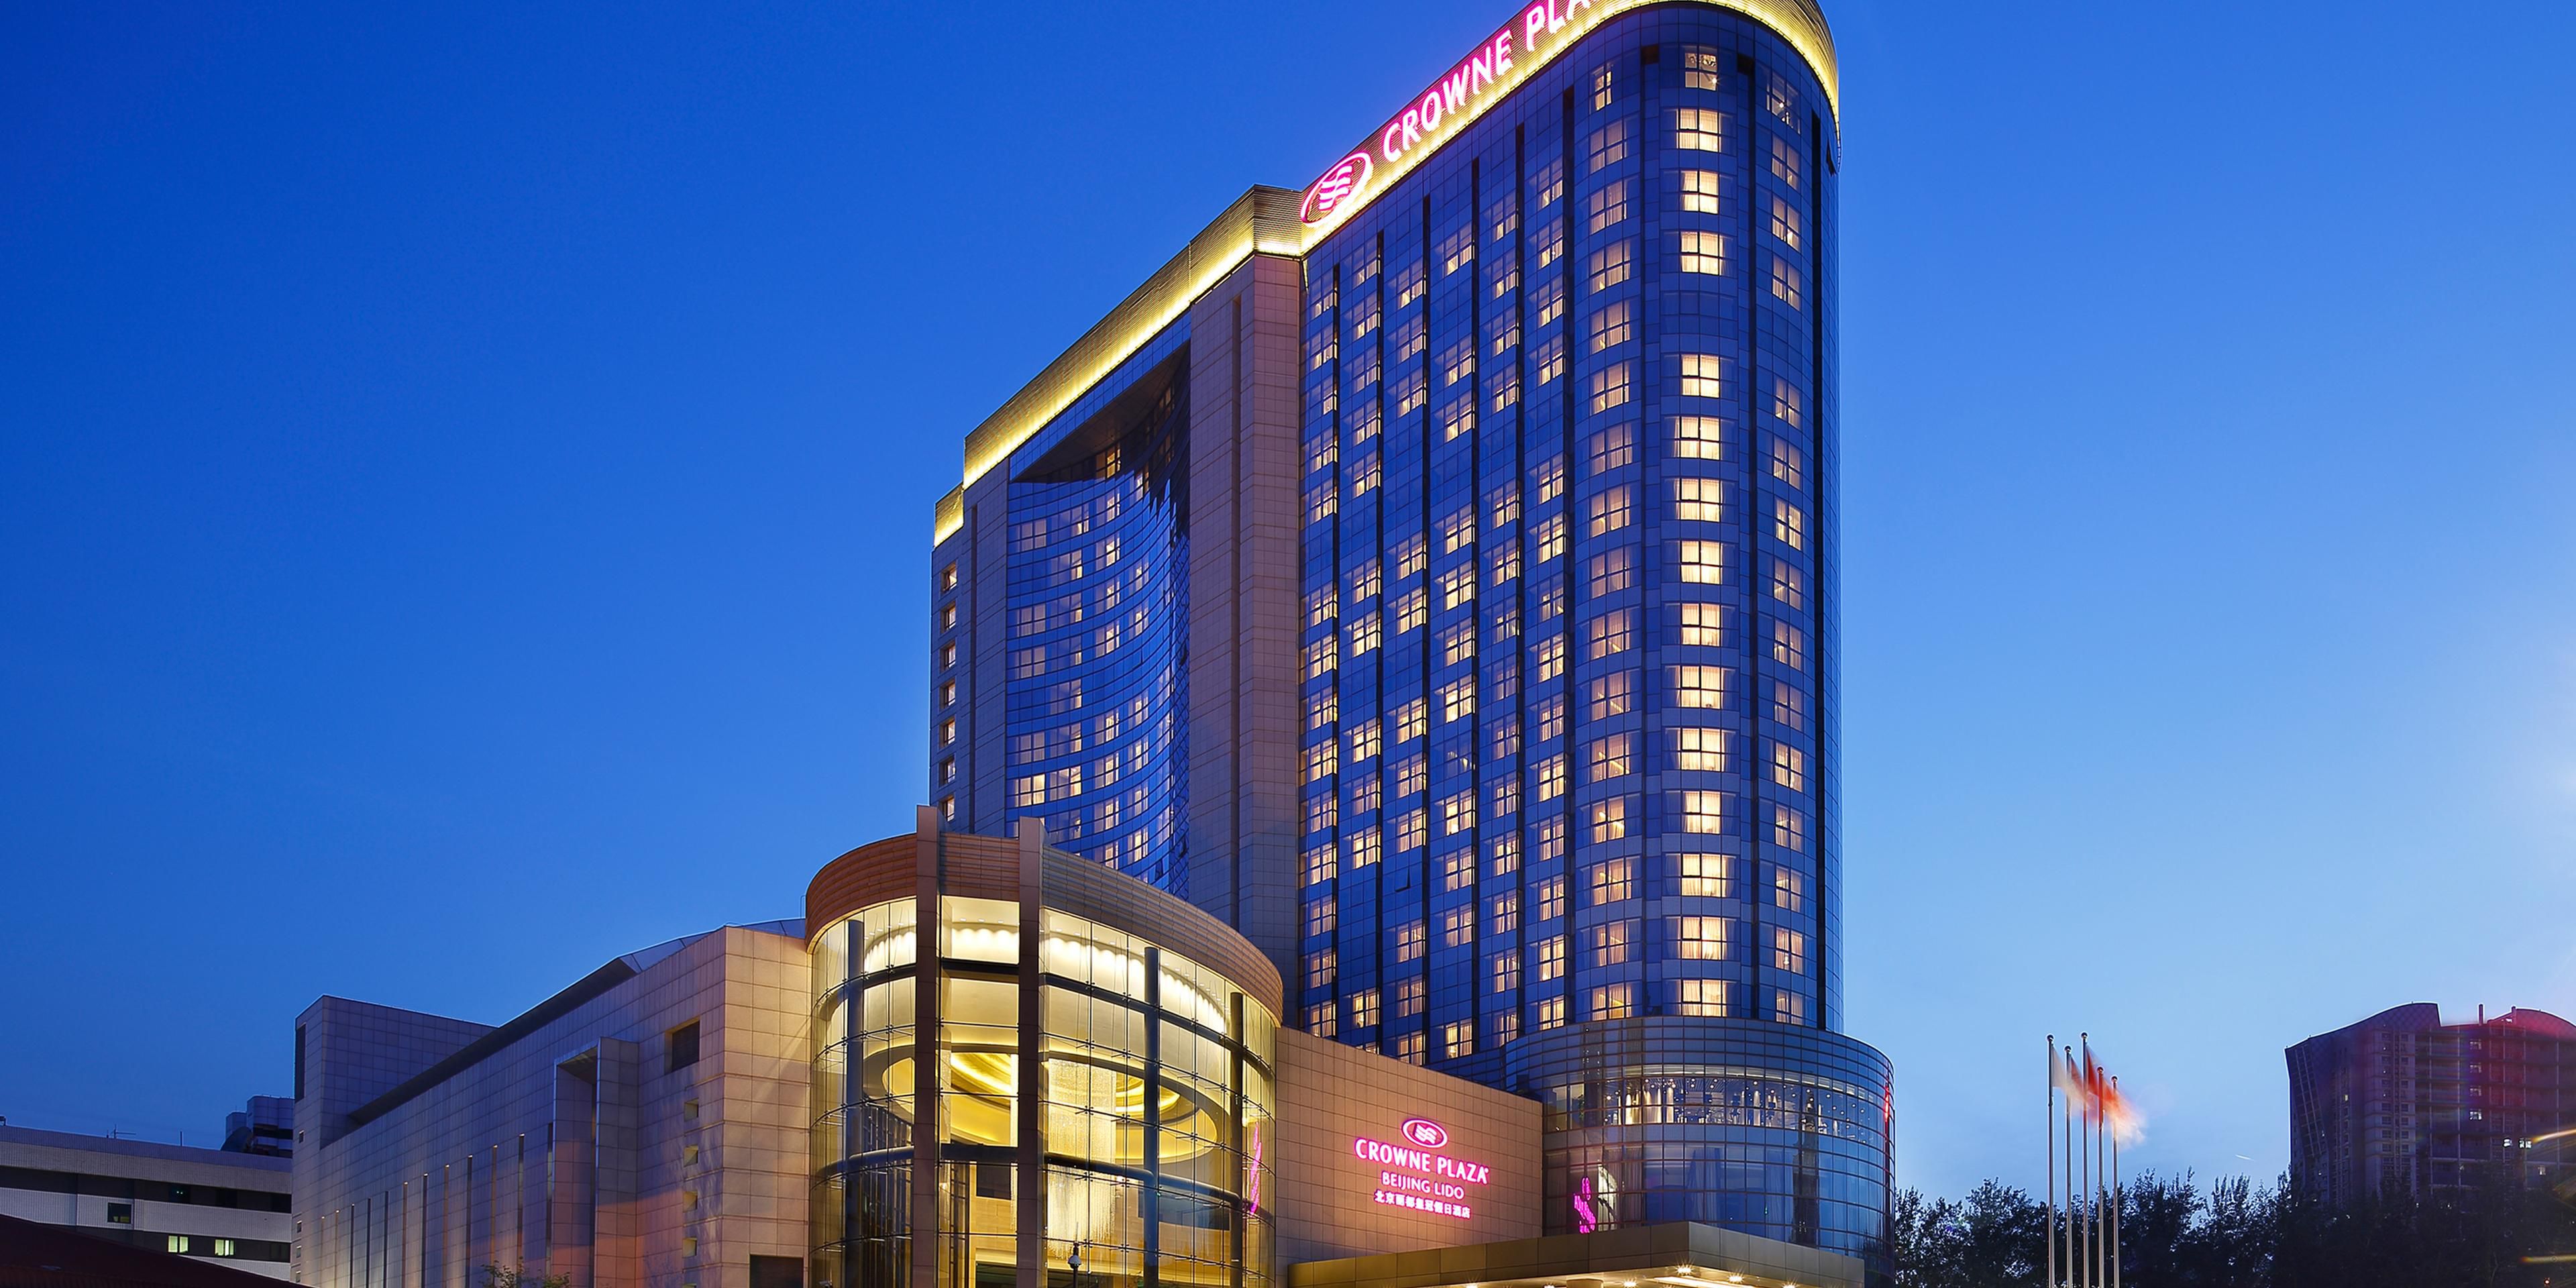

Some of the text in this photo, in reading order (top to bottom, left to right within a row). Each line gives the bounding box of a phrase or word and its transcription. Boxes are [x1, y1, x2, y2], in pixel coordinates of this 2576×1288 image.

[1383, 29, 1512, 162] CROWNE
[1356, 1138, 1489, 1184] CROWNE PLAZA
[1382, 1172, 1464, 1199] BEIJING LIDO
